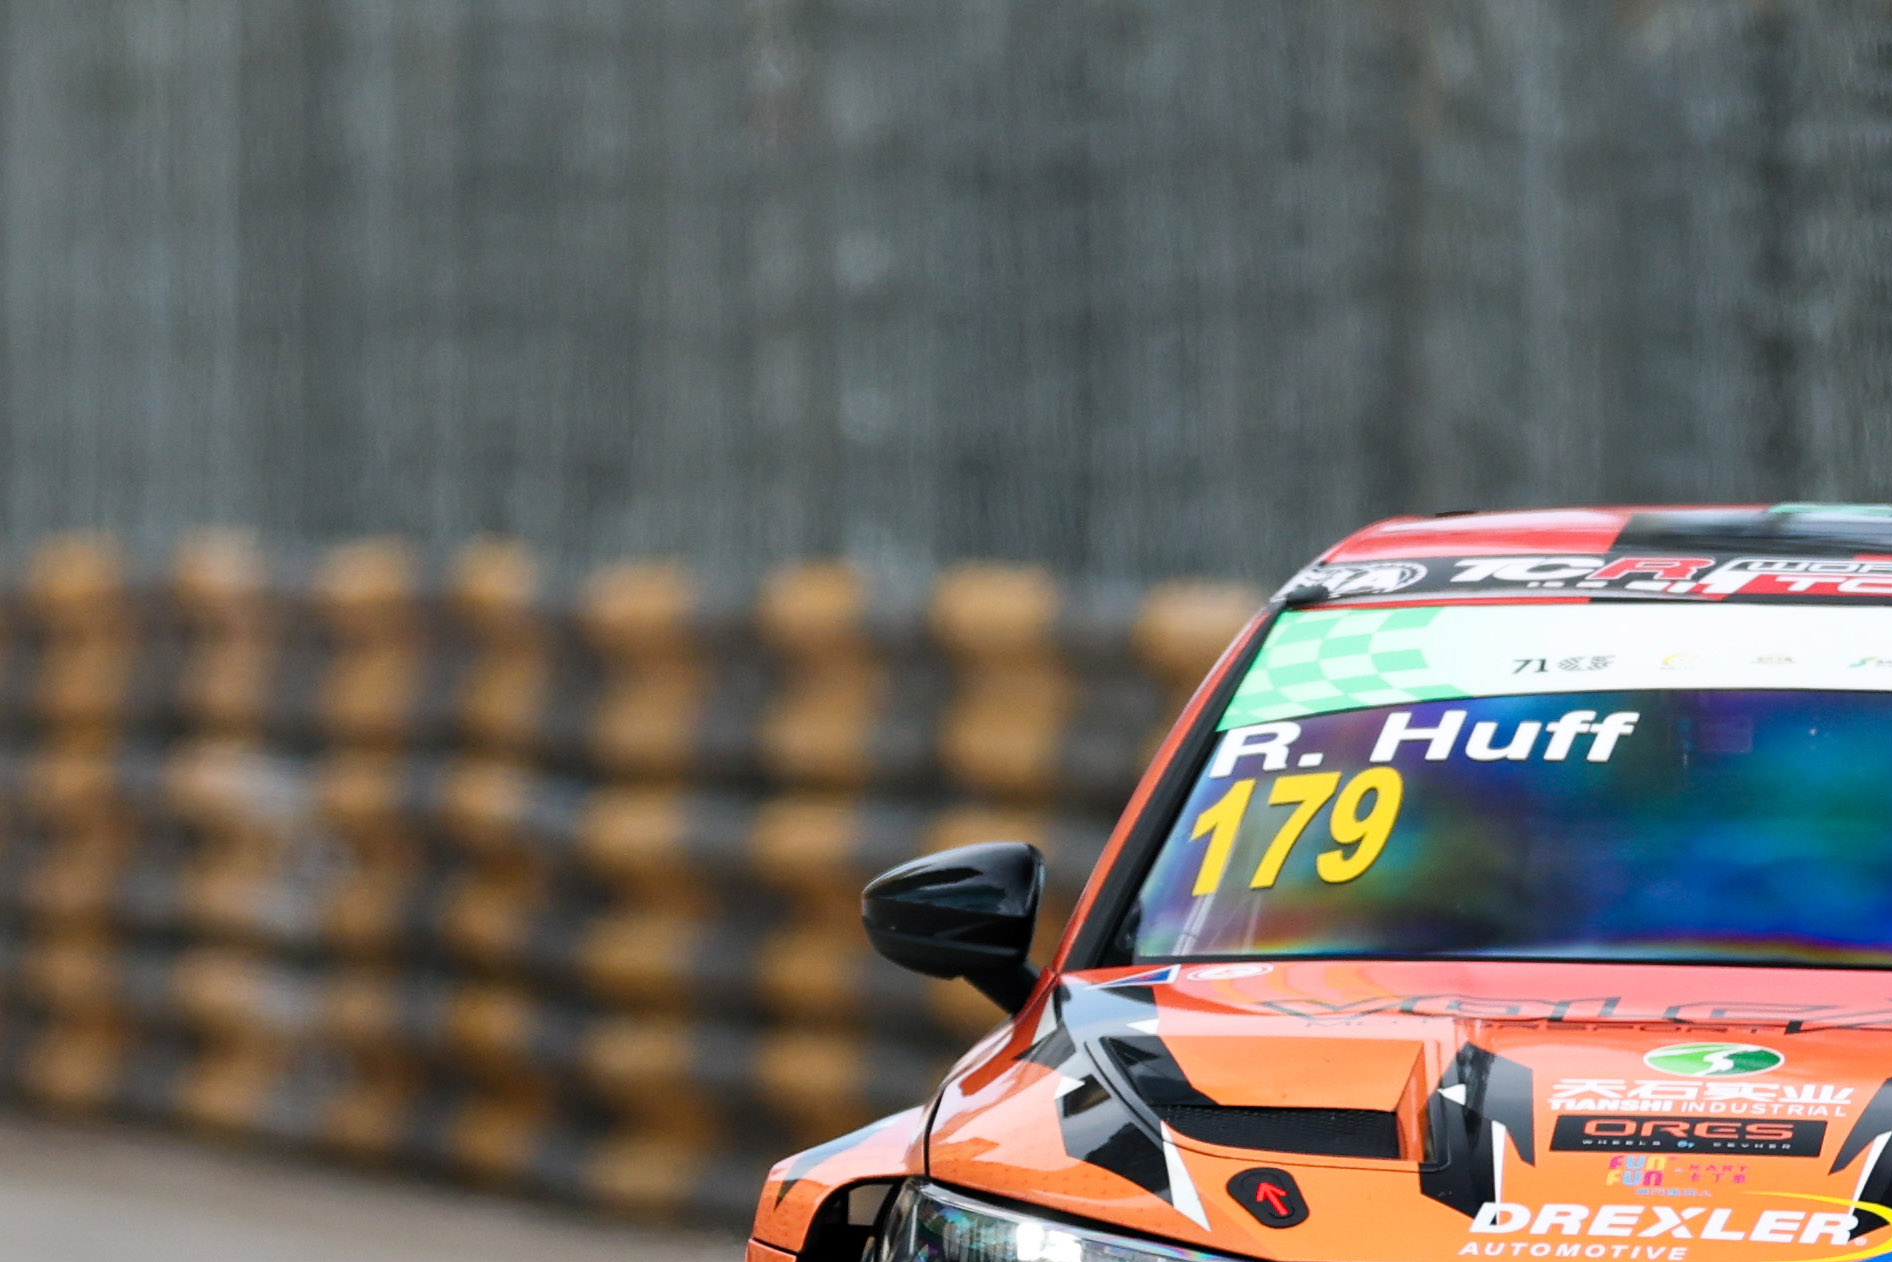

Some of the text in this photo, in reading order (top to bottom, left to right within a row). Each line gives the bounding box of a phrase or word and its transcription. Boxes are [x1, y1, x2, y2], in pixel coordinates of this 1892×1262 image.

[1450, 556, 1716, 582] TCR
[1511, 658, 1549, 674] 71
[1208, 710, 1640, 779] R. Huff
[1189, 766, 1404, 897] 179
[1552, 1078, 1854, 1105] 天石实业
[1550, 1098, 1848, 1118] TIANSHI INDUSTRIAL
[1468, 1201, 1860, 1247] DREXLER
[1457, 1241, 1690, 1262] AUTOMOTIVE
